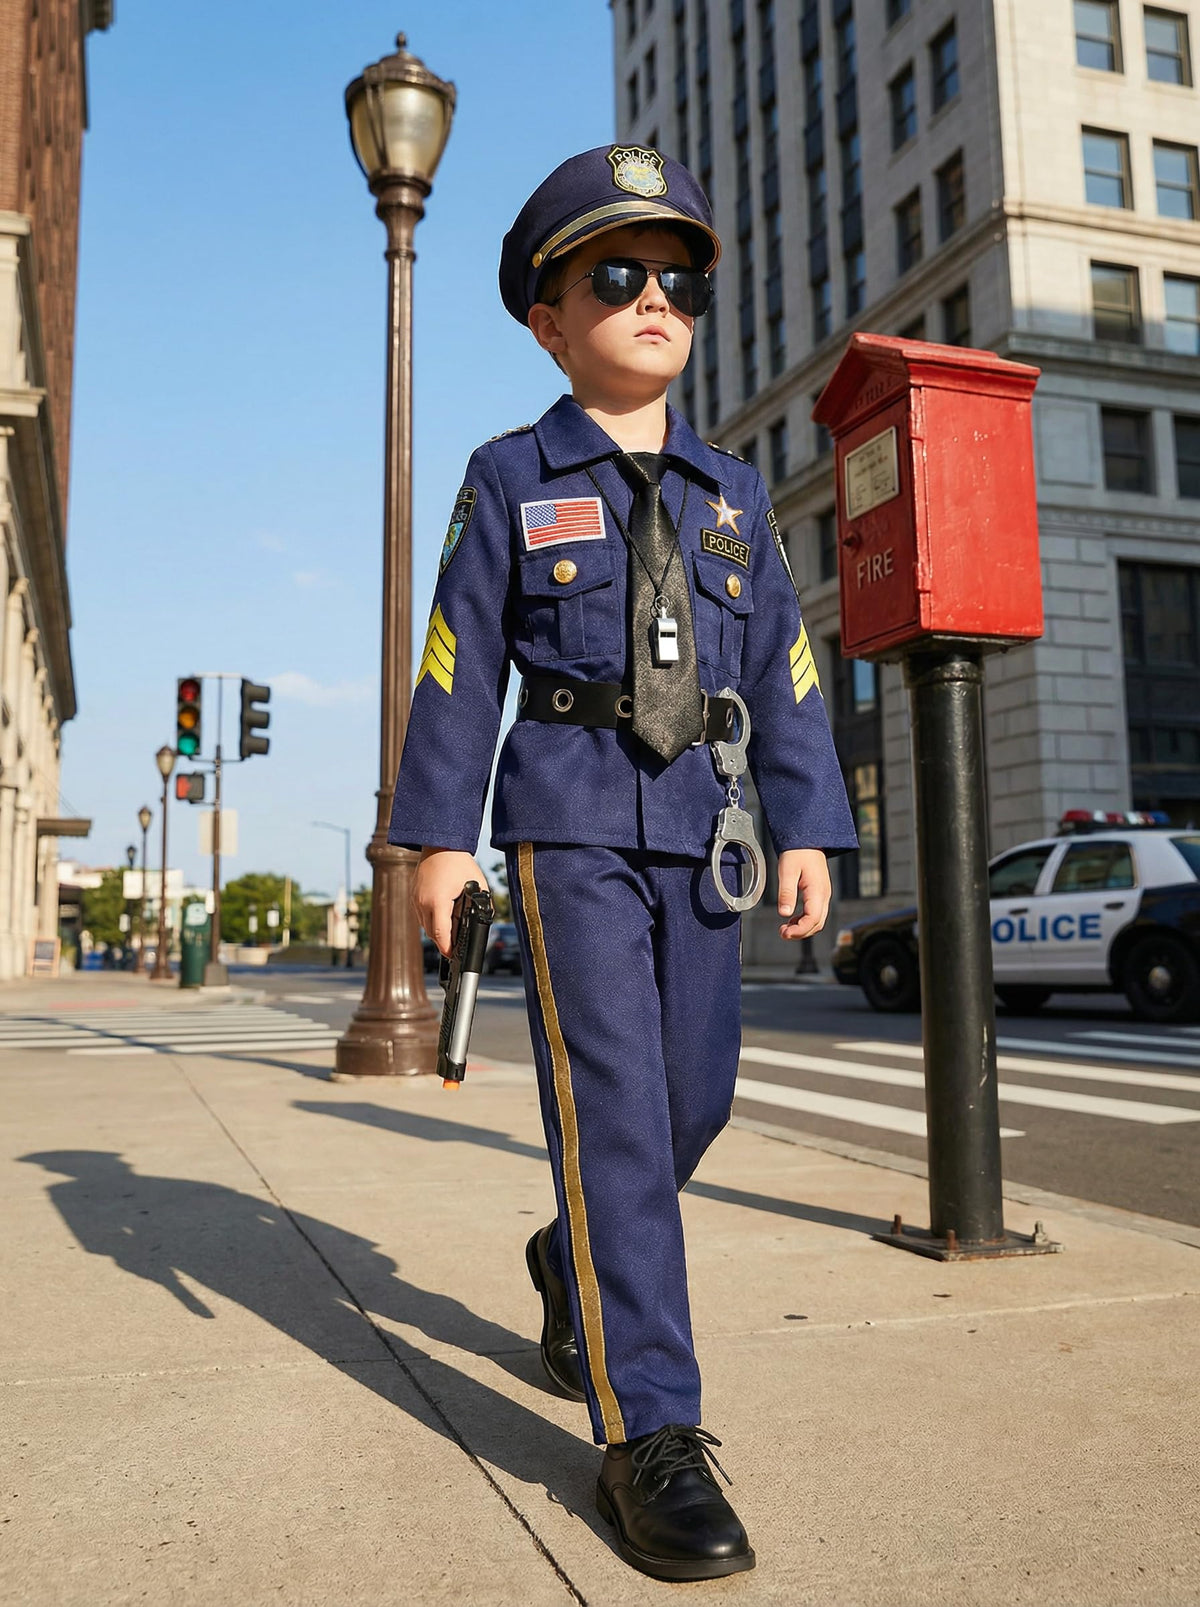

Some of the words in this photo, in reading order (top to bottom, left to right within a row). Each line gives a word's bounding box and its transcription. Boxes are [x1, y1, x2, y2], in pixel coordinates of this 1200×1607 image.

[615, 151, 658, 165] POLICE
[709, 535, 746, 559] POLICE
[856, 548, 894, 589] FIRE
[992, 914, 1101, 943] OLICE
